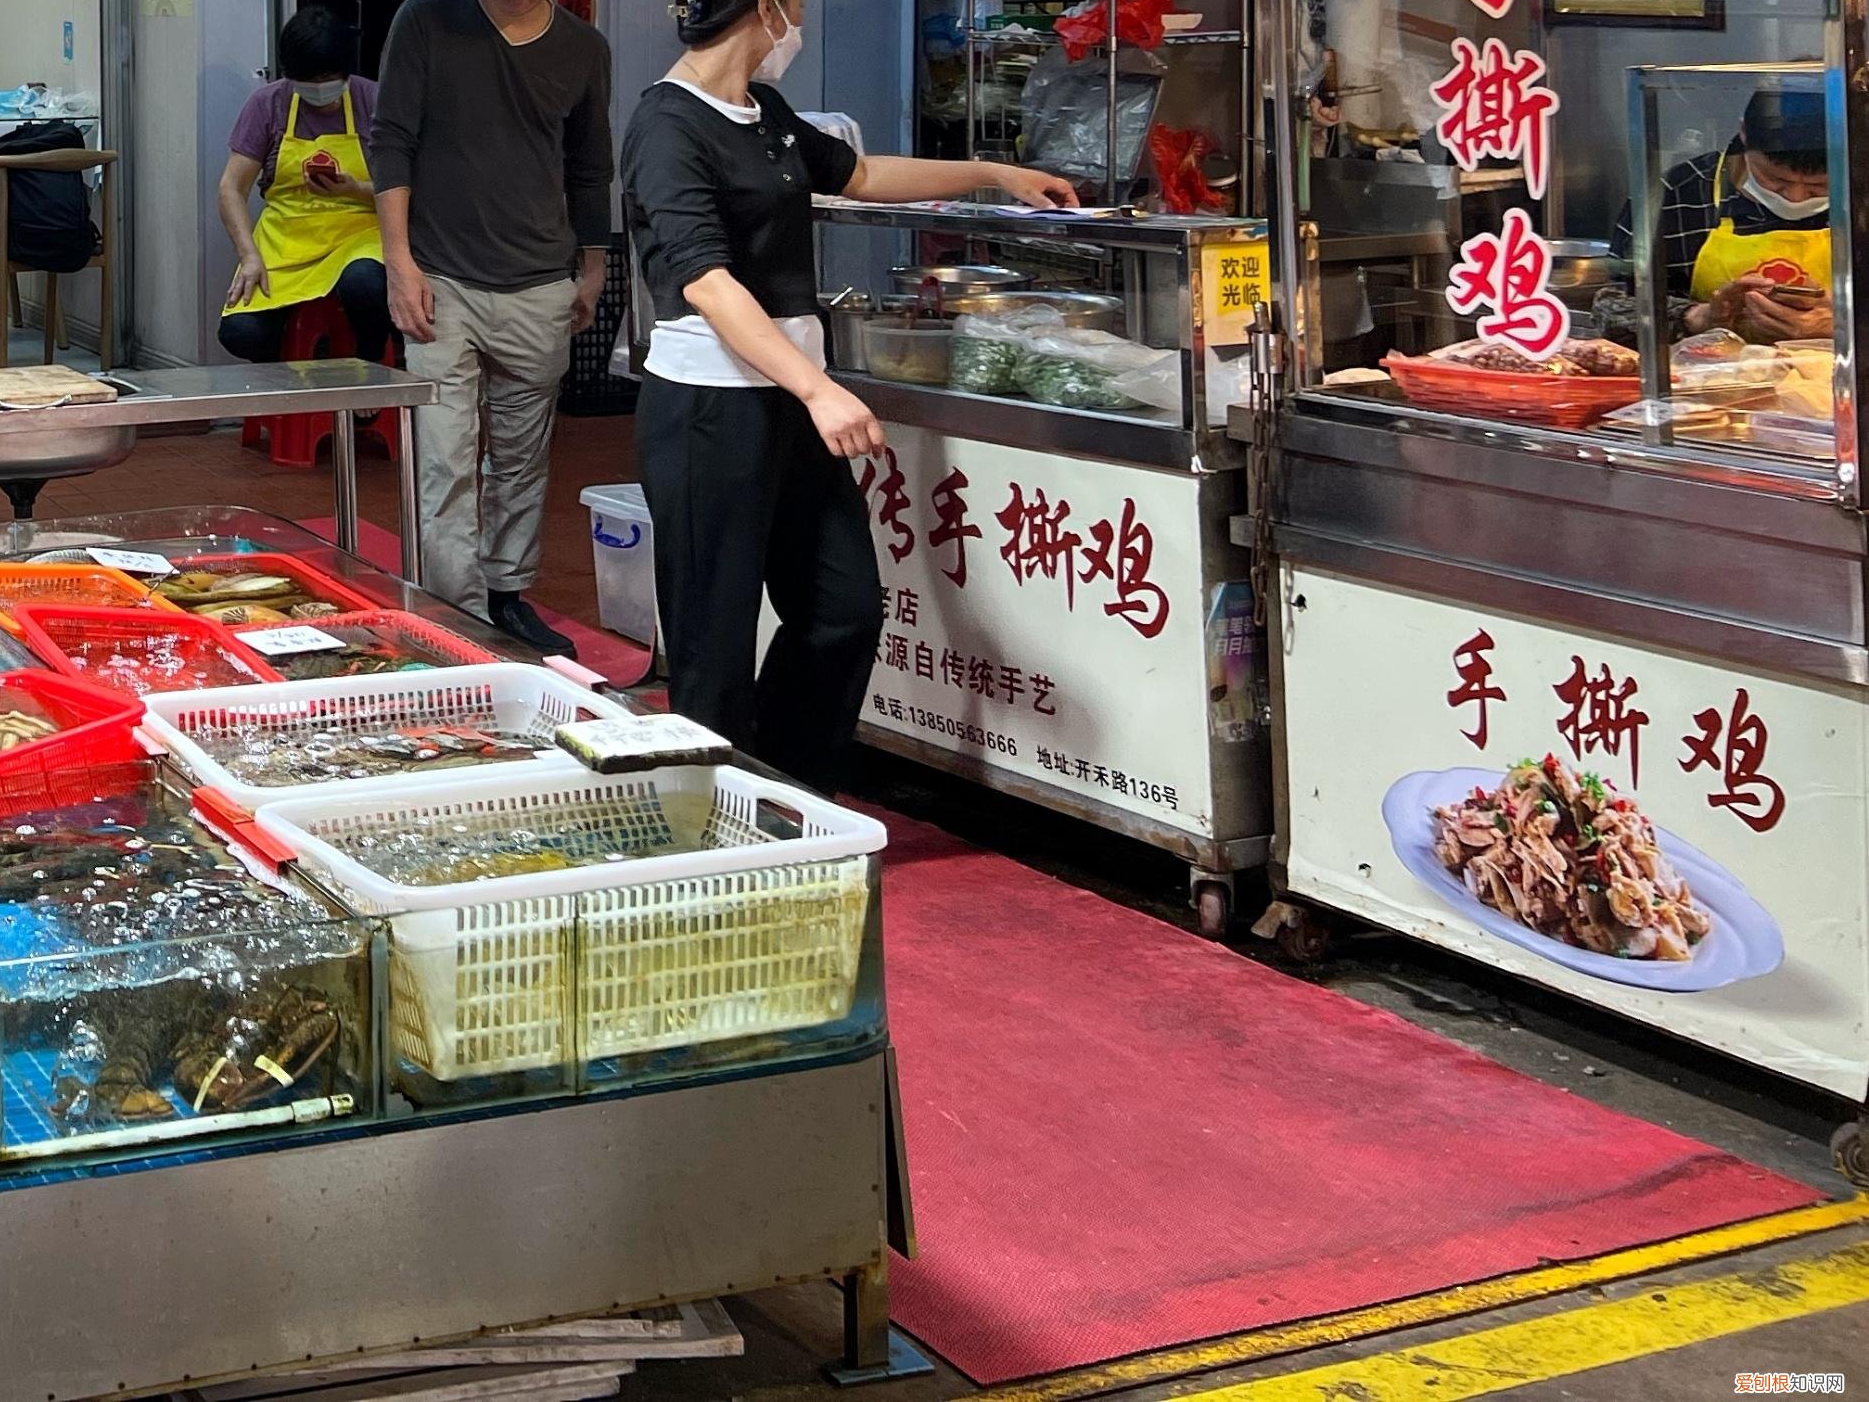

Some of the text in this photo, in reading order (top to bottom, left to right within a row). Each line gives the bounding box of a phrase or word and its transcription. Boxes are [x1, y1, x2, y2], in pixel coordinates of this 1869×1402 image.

[1221, 256, 1260, 279] 欢迎
[1222, 282, 1261, 306] 光临
[875, 632, 1056, 716] 源自传统手艺
[1446, 627, 1787, 834] 手撕鸡
[1036, 745, 1179, 811] 地址:开禾路136号
